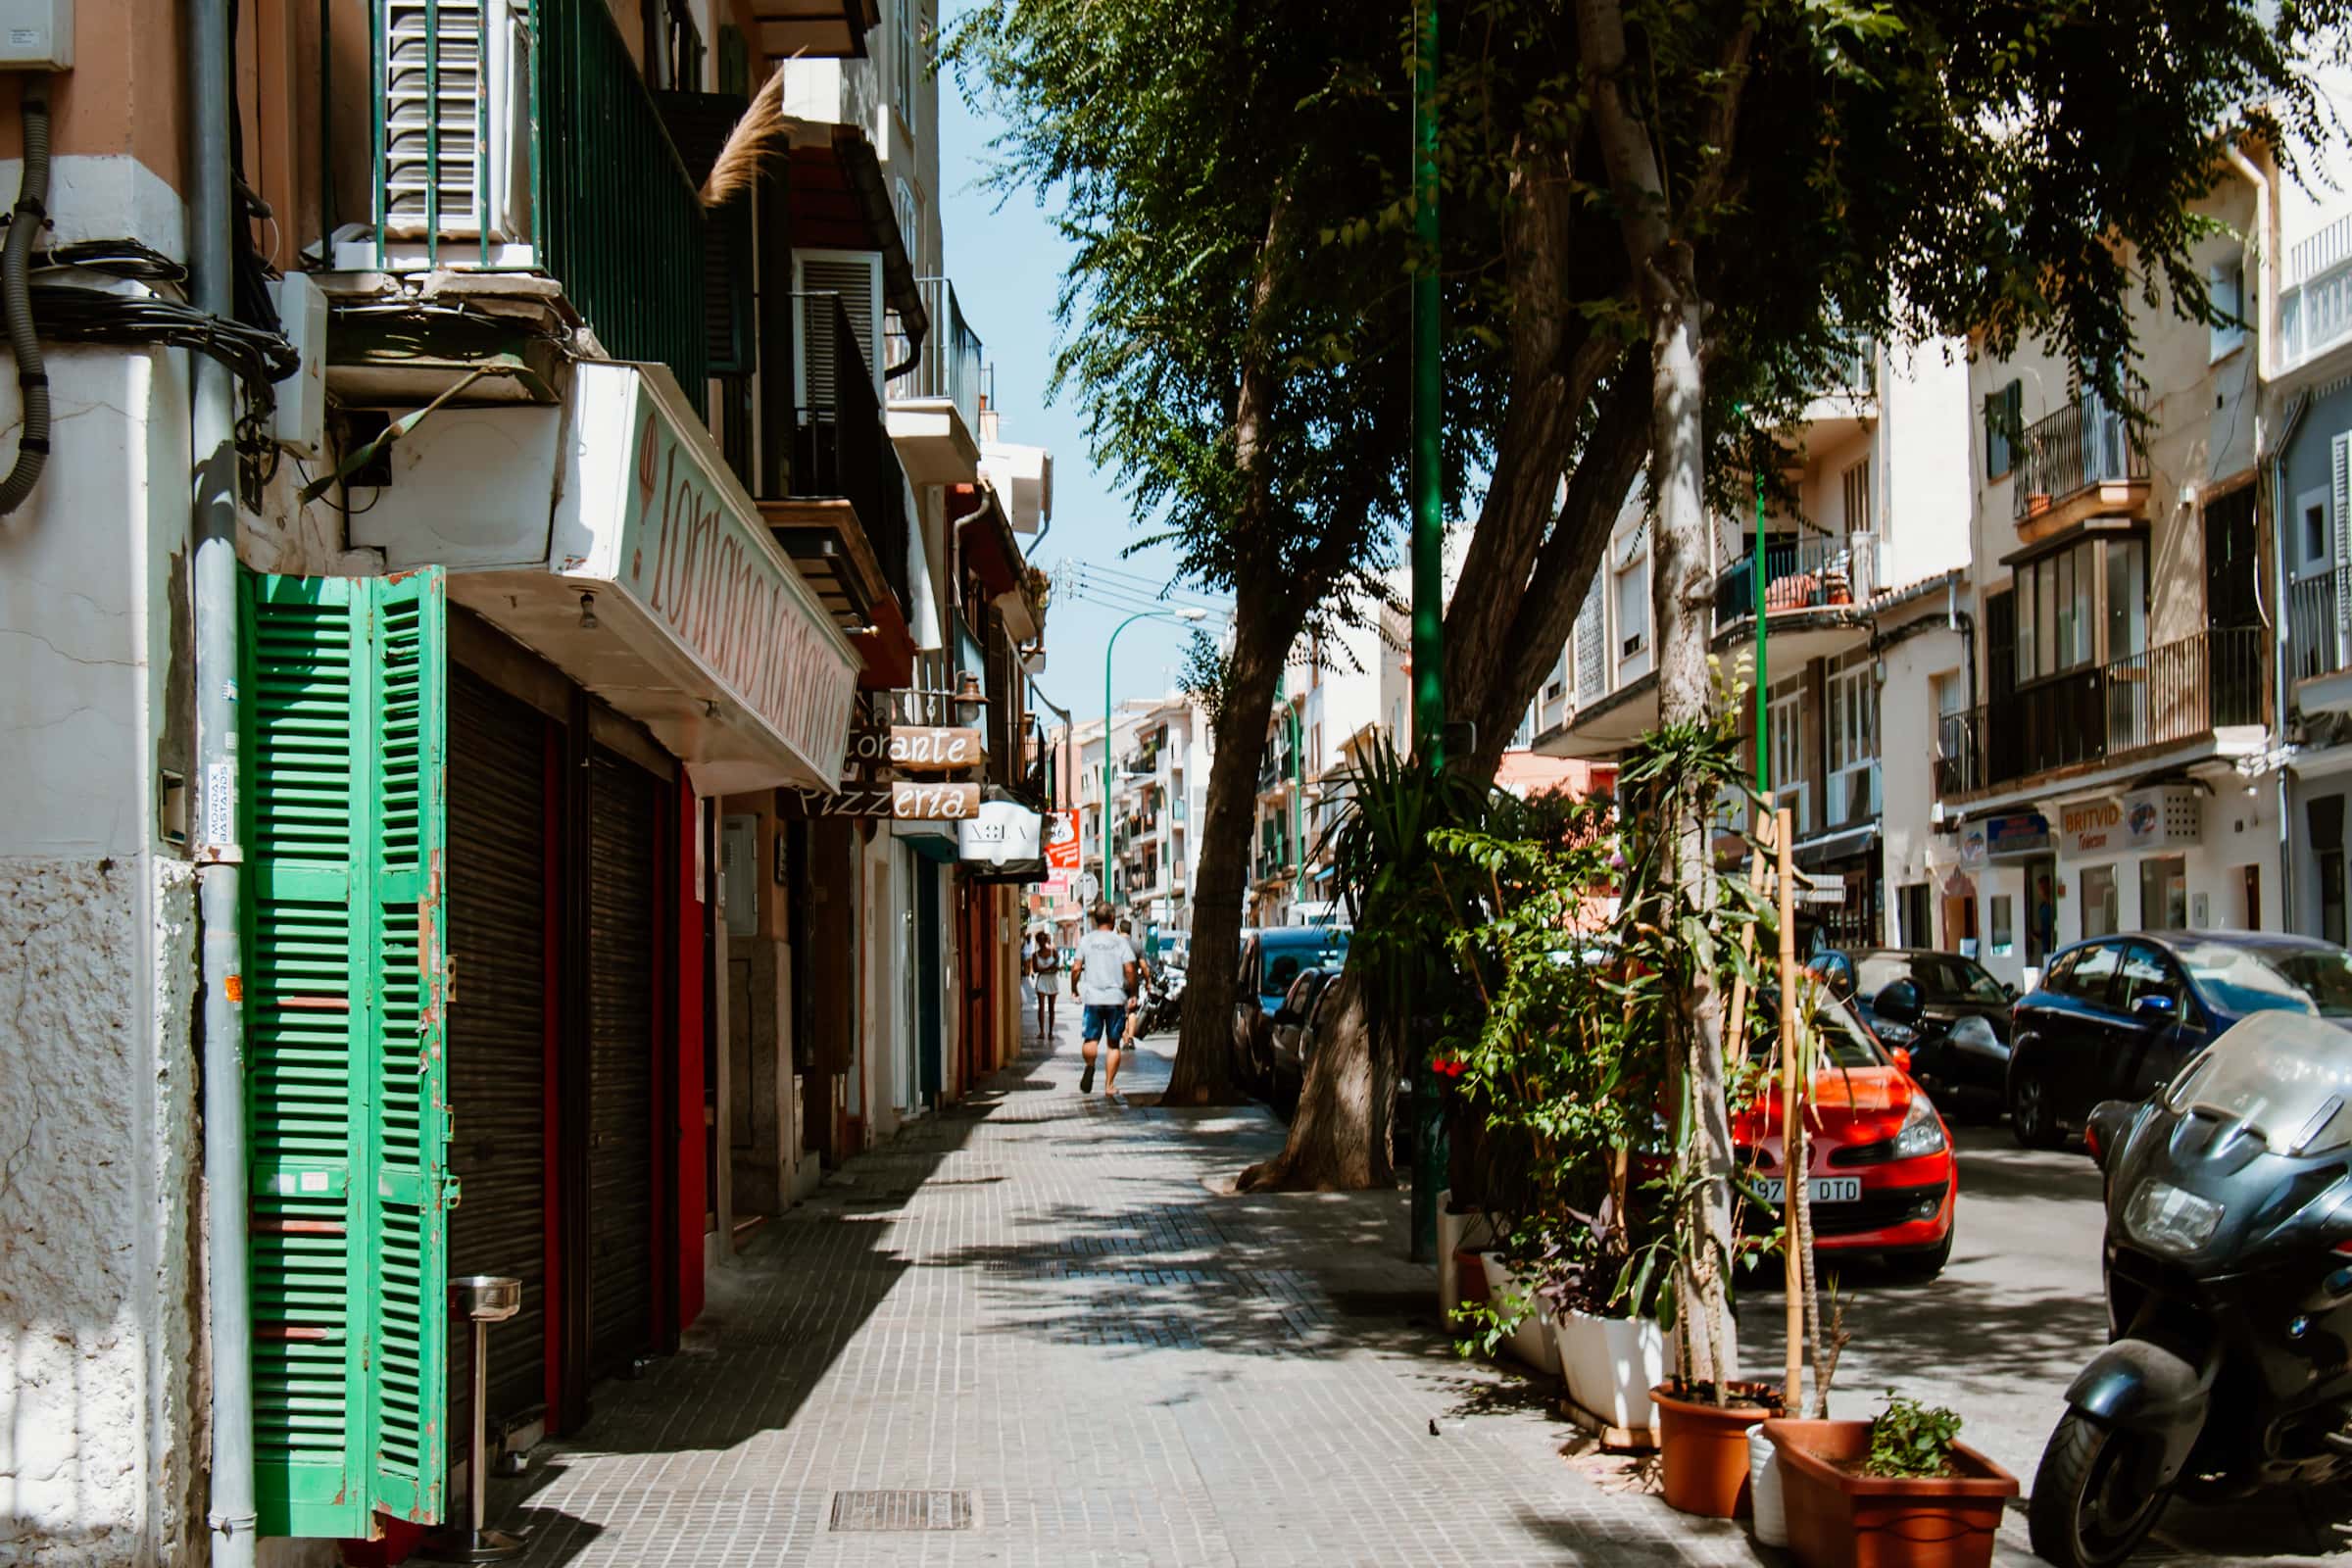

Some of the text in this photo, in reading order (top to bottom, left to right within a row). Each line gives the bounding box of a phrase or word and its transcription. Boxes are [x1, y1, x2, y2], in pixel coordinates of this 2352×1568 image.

[799, 786, 967, 817] Pizzeria
[2065, 805, 2120, 833] BRITVID
[1820, 1181, 1857, 1200] DTD
